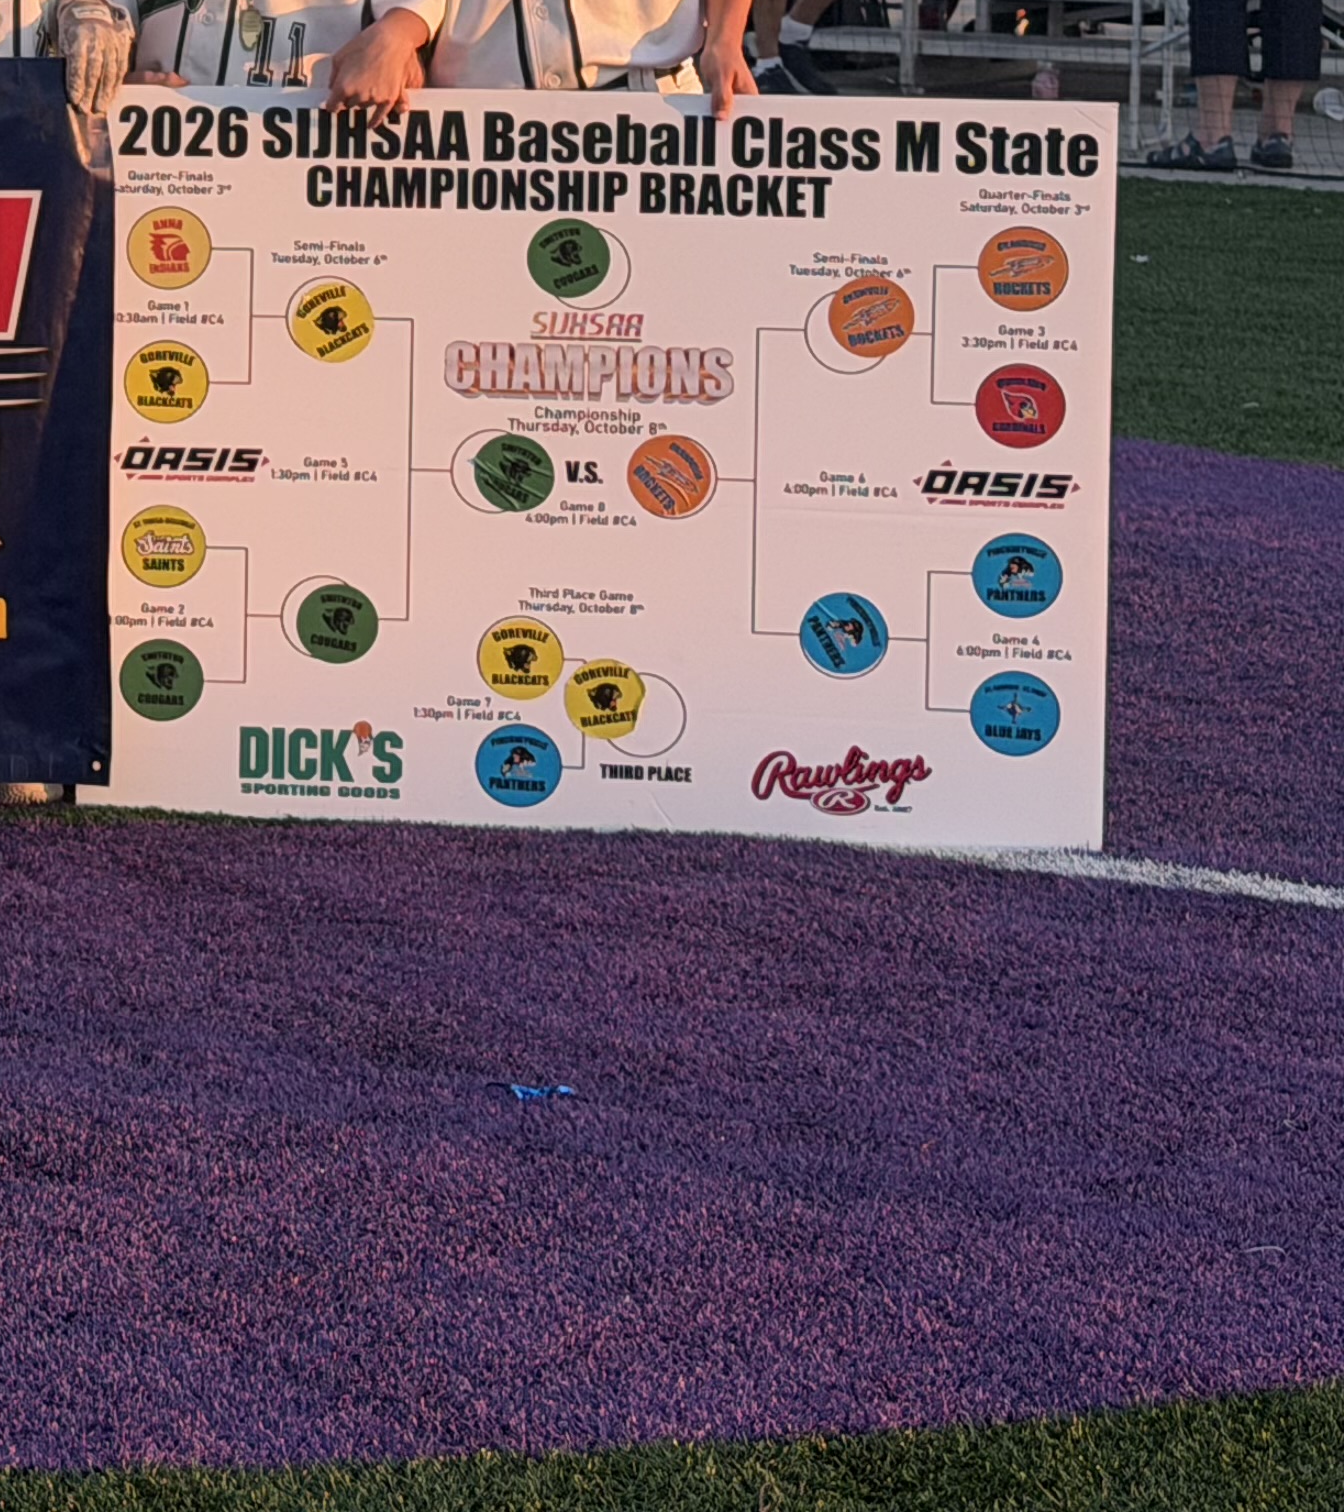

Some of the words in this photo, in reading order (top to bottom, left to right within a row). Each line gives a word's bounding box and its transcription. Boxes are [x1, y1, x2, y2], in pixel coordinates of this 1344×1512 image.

[118, 105, 249, 158] 2026
[263, 107, 471, 160] SIJHSAA
[484, 111, 714, 166] Baseball
[731, 116, 881, 171] Class
[896, 121, 939, 173] M
[955, 121, 1100, 177] State
[128, 171, 213, 182] Quarter-Finals
[167, 184, 212, 194] October
[307, 165, 628, 214] CHAMPIONSHIP
[639, 173, 833, 218] BRACKET
[978, 189, 1072, 203] Quarter-Finals
[1022, 203, 1070, 215] October
[293, 241, 365, 252] Semi-Finals
[325, 254, 369, 265] October
[813, 253, 888, 265] Semi-Finals
[147, 301, 180, 312] Game
[115, 313, 158, 324] 0:30am
[168, 313, 197, 324] Field
[531, 312, 644, 337] SIJHSAA
[998, 325, 1033, 336] Game
[1038, 326, 1045, 337] 3
[1019, 338, 1048, 350] Field
[444, 340, 735, 404] CHAMPIONS
[535, 406, 641, 422] Championship
[508, 418, 579, 436] Thursday,
[584, 420, 644, 434] October
[121, 446, 263, 472] OASIS
[304, 457, 337, 468] Game
[321, 470, 349, 481] Field
[565, 461, 604, 484] V.S.
[819, 471, 854, 483] Game
[921, 470, 1073, 499] OASIS
[839, 485, 869, 497] Field
[560, 500, 594, 512] Game
[579, 514, 608, 526] Field
[143, 558, 184, 571] SAINTS
[529, 587, 559, 599] Third
[563, 589, 595, 600] Place
[600, 590, 634, 601] Game
[141, 603, 174, 614] Game
[178, 604, 185, 614] 2
[579, 603, 625, 614] October
[158, 616, 187, 627] Field
[492, 628, 549, 643] GOREVILLE
[993, 634, 1029, 645] Game
[1013, 648, 1042, 660] Field
[492, 673, 550, 686] BLACKCATS
[574, 666, 630, 685] GOREVILLE
[447, 696, 481, 707] Game
[464, 710, 493, 720] Field
[600, 763, 644, 780] THIRD
[648, 765, 692, 782] PLACE
[751, 745, 932, 804] Rawlings
[240, 783, 330, 796] SPORTING
[338, 785, 401, 799] GOODS
